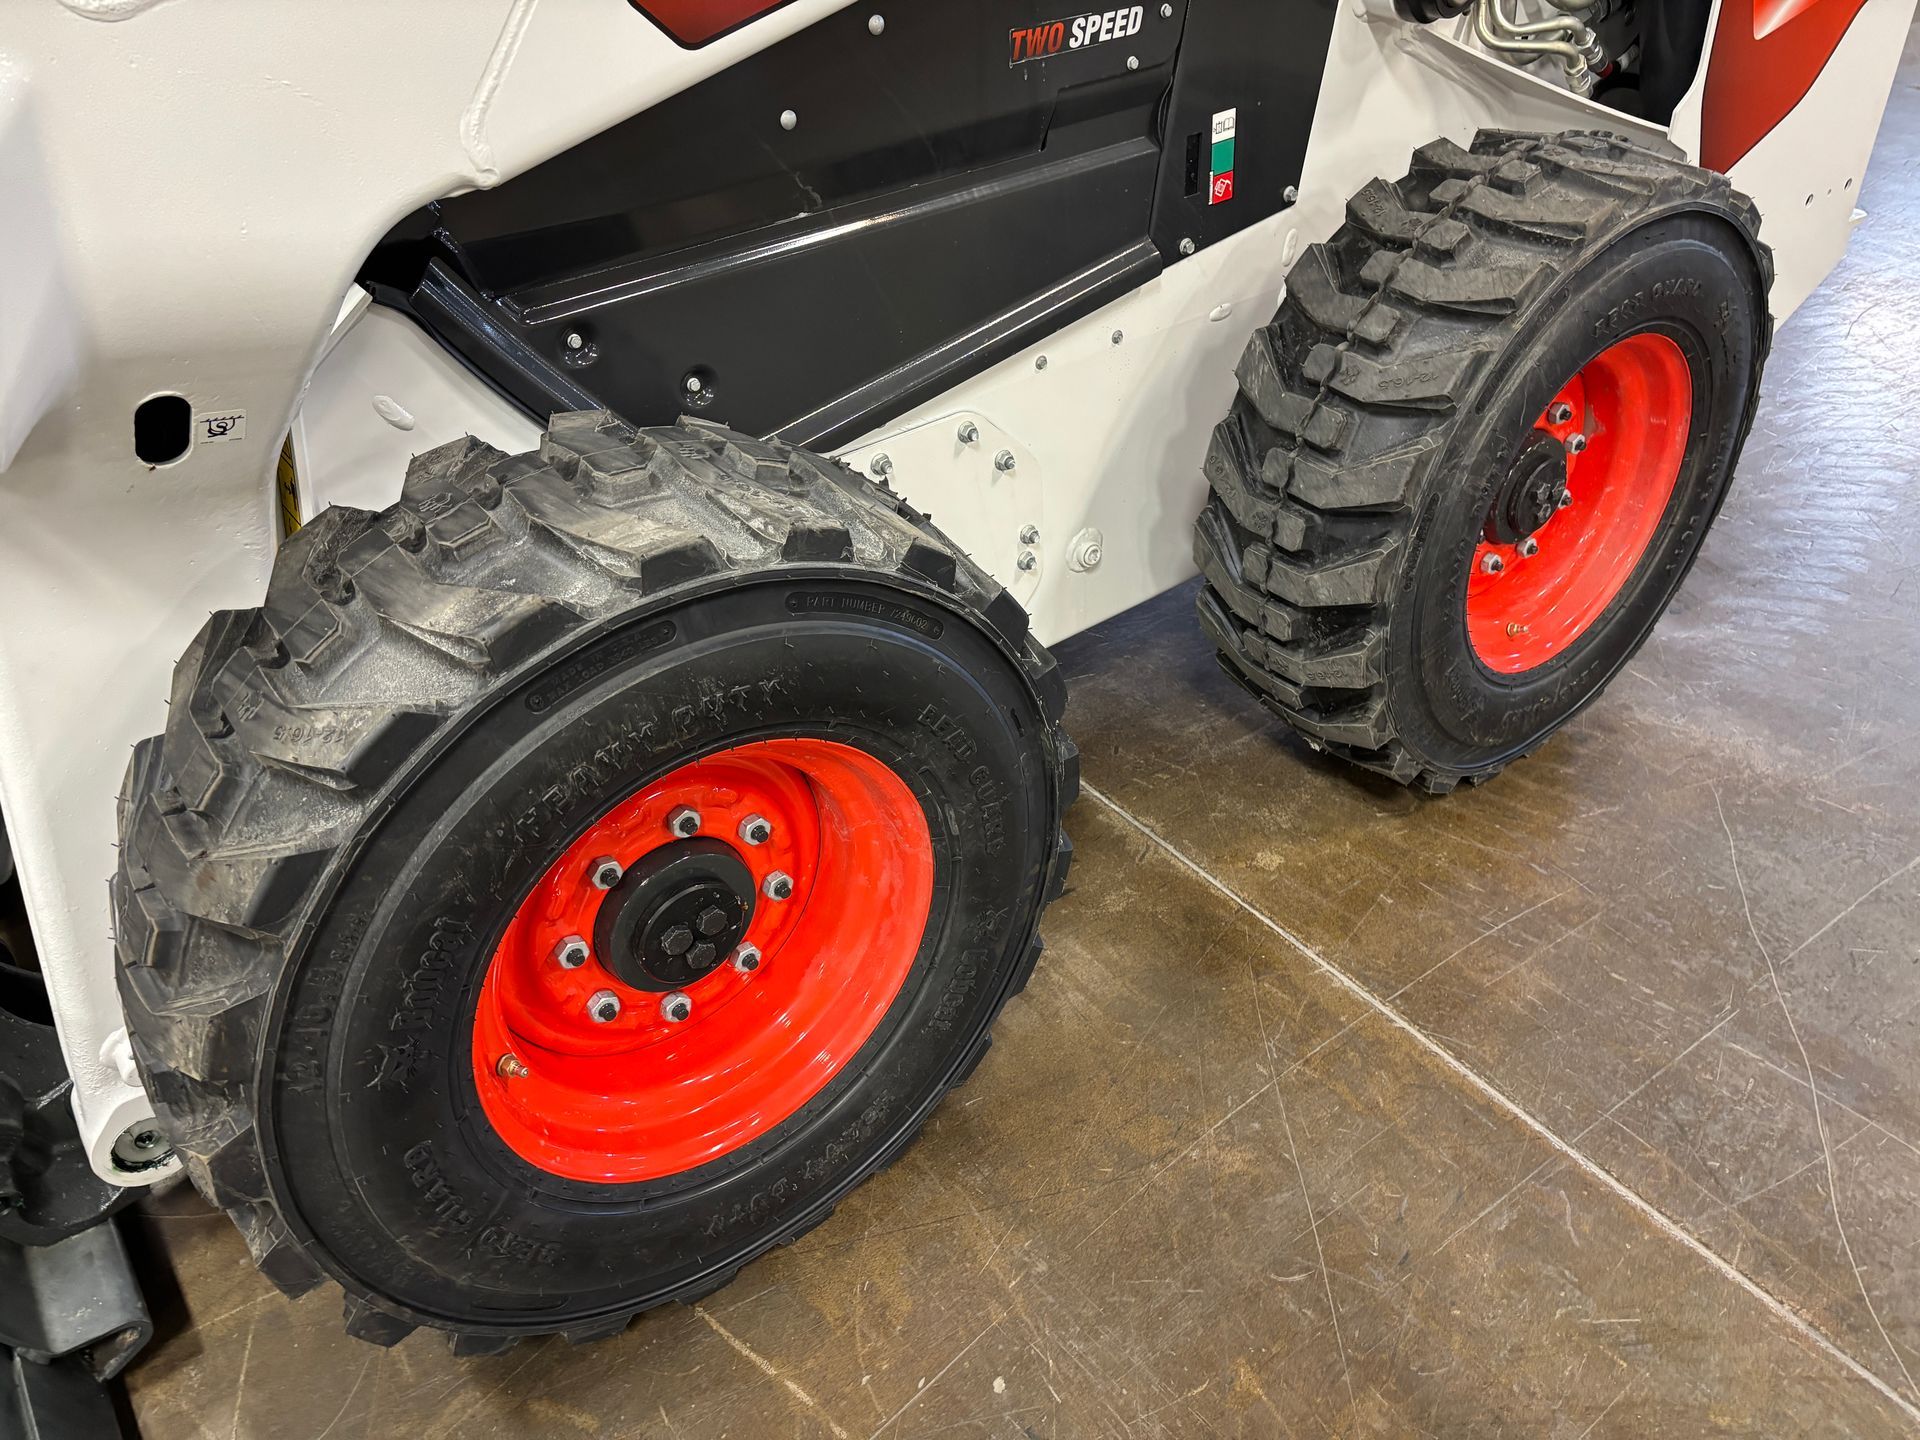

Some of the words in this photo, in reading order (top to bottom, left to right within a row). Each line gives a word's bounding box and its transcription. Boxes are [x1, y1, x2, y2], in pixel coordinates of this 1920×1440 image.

[1012, 22, 1064, 61] TWO
[1069, 5, 1144, 49] SPEED
[273, 725, 345, 744] 12-16.5
[916, 702, 979, 764] BEAD
[967, 764, 1006, 858] GUARD
